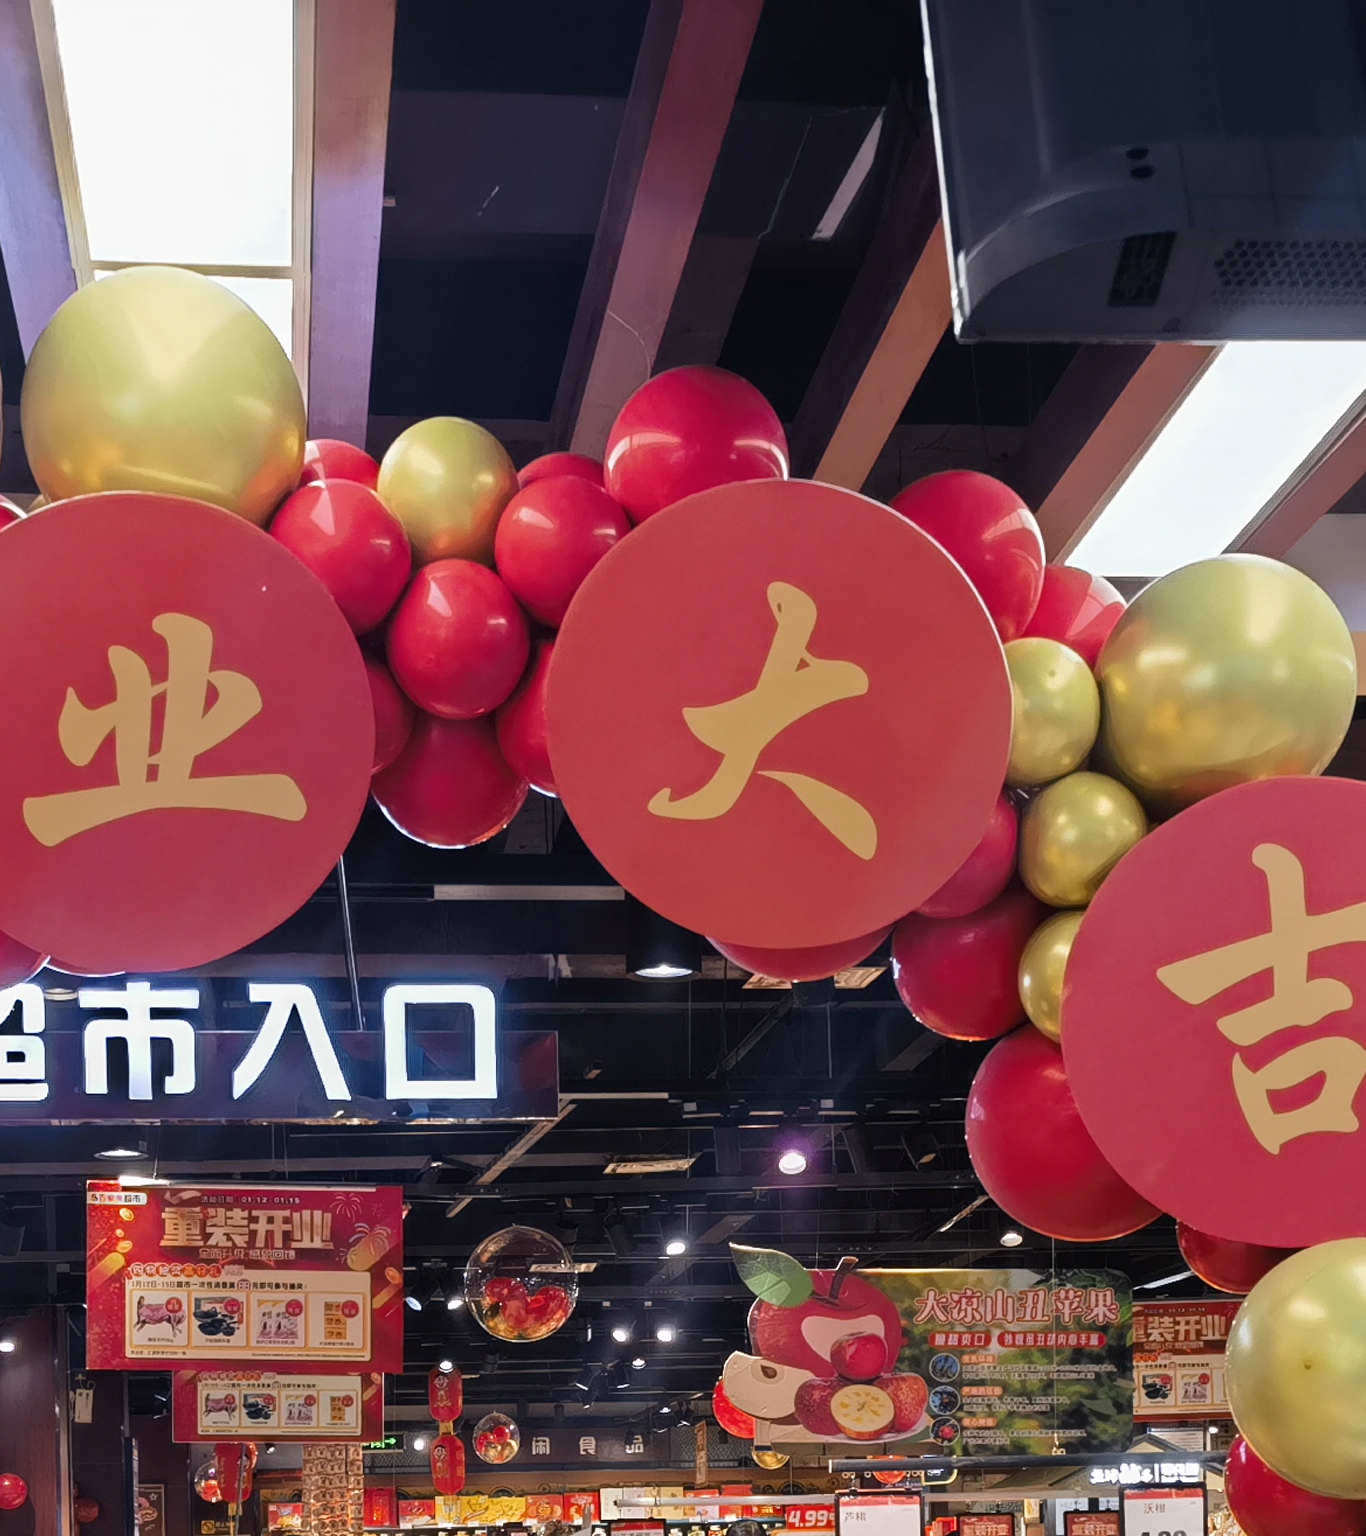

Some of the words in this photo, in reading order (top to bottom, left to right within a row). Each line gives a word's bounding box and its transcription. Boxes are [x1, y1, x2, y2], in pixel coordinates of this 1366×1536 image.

[23, 612, 308, 847] 业
[647, 581, 879, 860] 大
[159, 1207, 334, 1249] 重装开业
[914, 1287, 1120, 1325] 大凉山丑苹果
[1144, 1503, 1165, 1514] 沃柑
